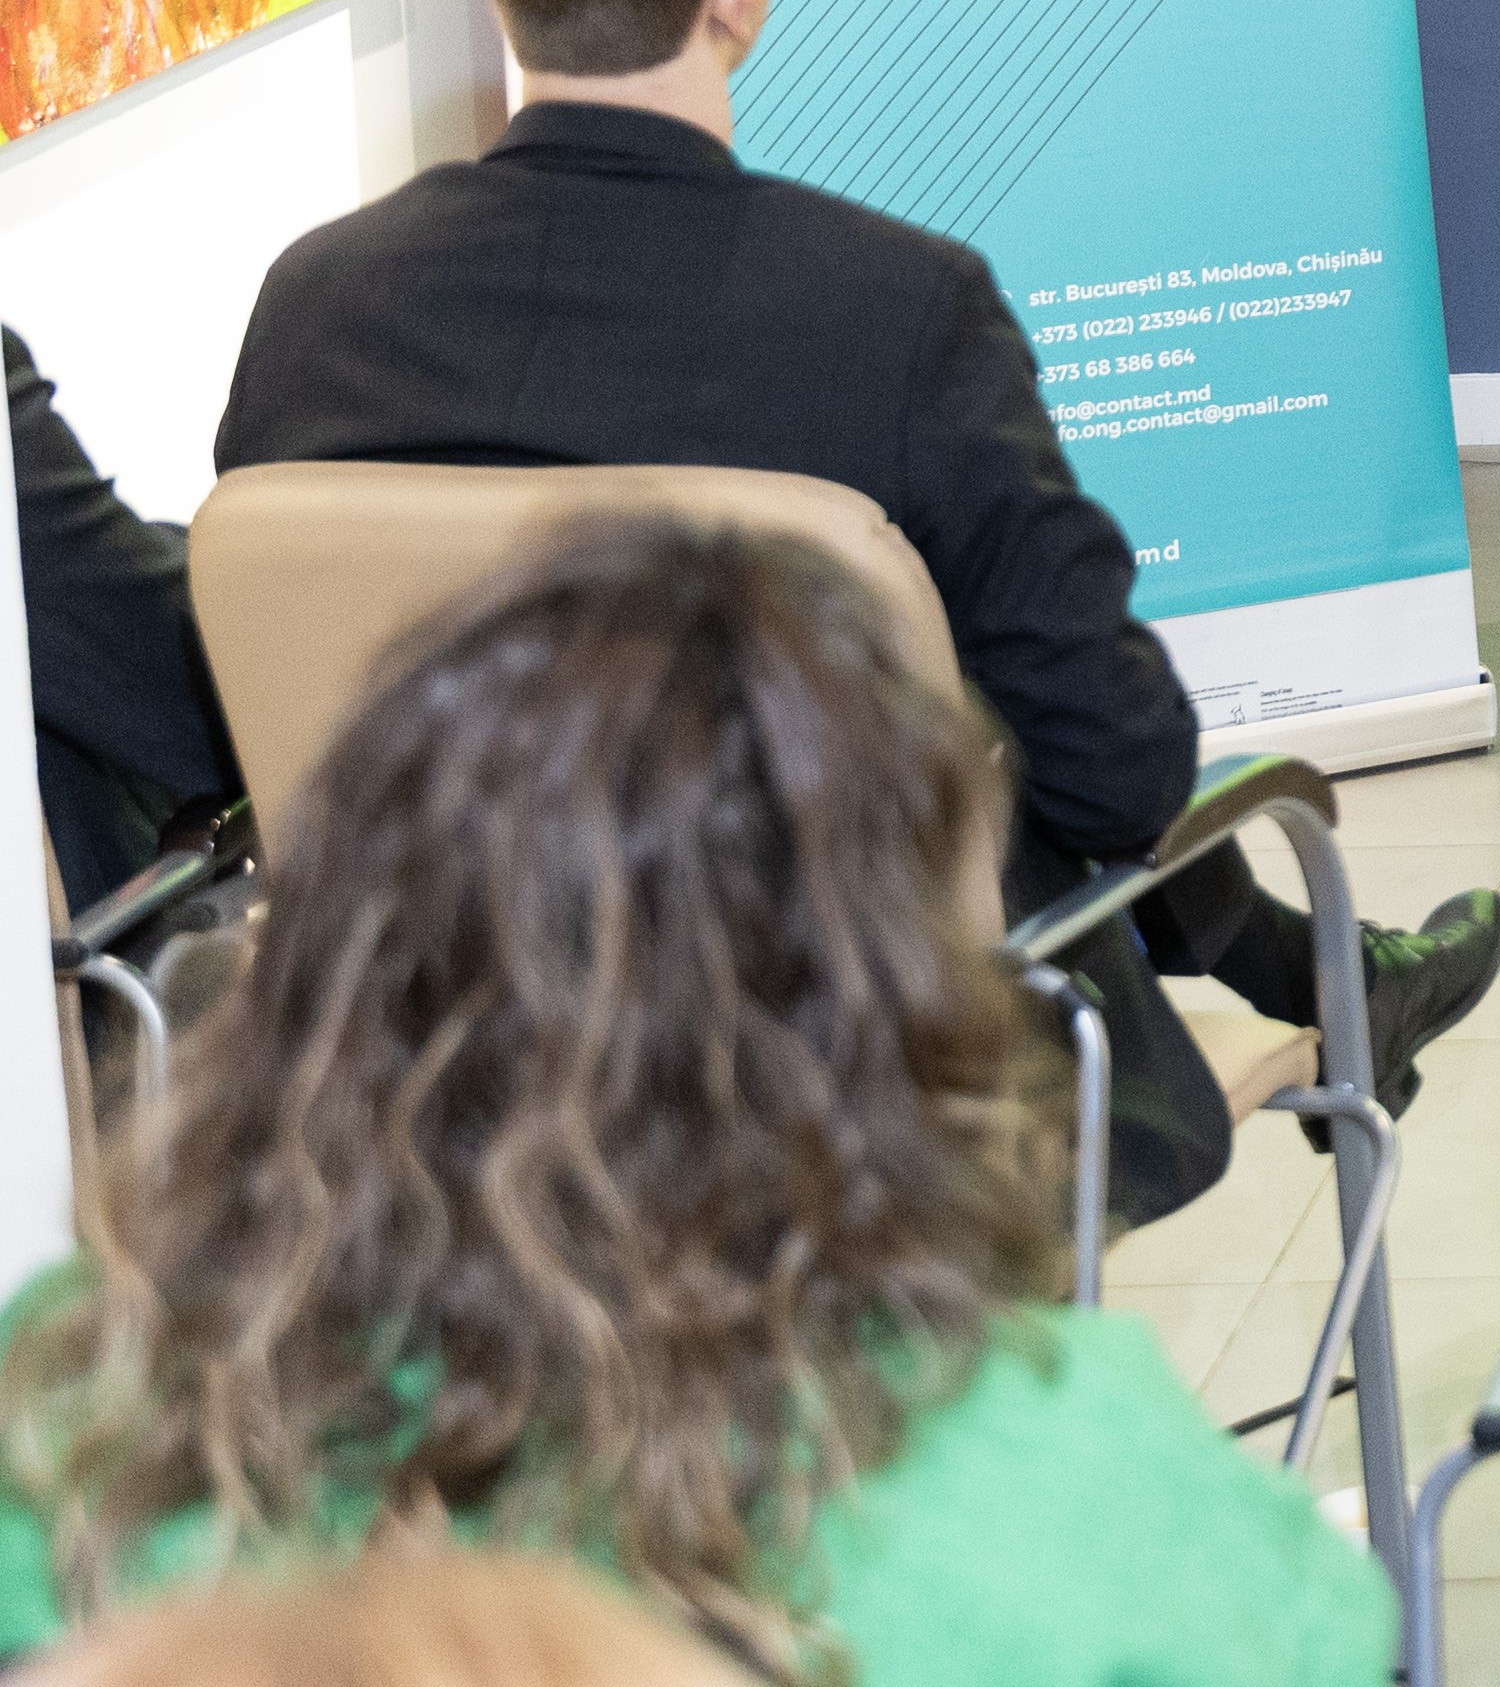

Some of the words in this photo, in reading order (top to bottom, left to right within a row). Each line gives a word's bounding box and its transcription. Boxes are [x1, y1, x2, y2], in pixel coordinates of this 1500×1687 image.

[1029, 288, 1061, 306] str.
[1066, 272, 1162, 301] București
[1167, 269, 1196, 288] 83,
[1202, 261, 1293, 284] Moldova,
[1297, 248, 1383, 273] Chișinău
[1032, 323, 1078, 344] +373
[1083, 315, 1134, 341] (022)
[1139, 306, 1212, 331] 233946
[1216, 302, 1226, 323] /
[1229, 289, 1352, 321] (022)233947
[1085, 359, 1111, 377] 68
[1115, 353, 1154, 373] 386
[1158, 348, 1196, 367] 664
